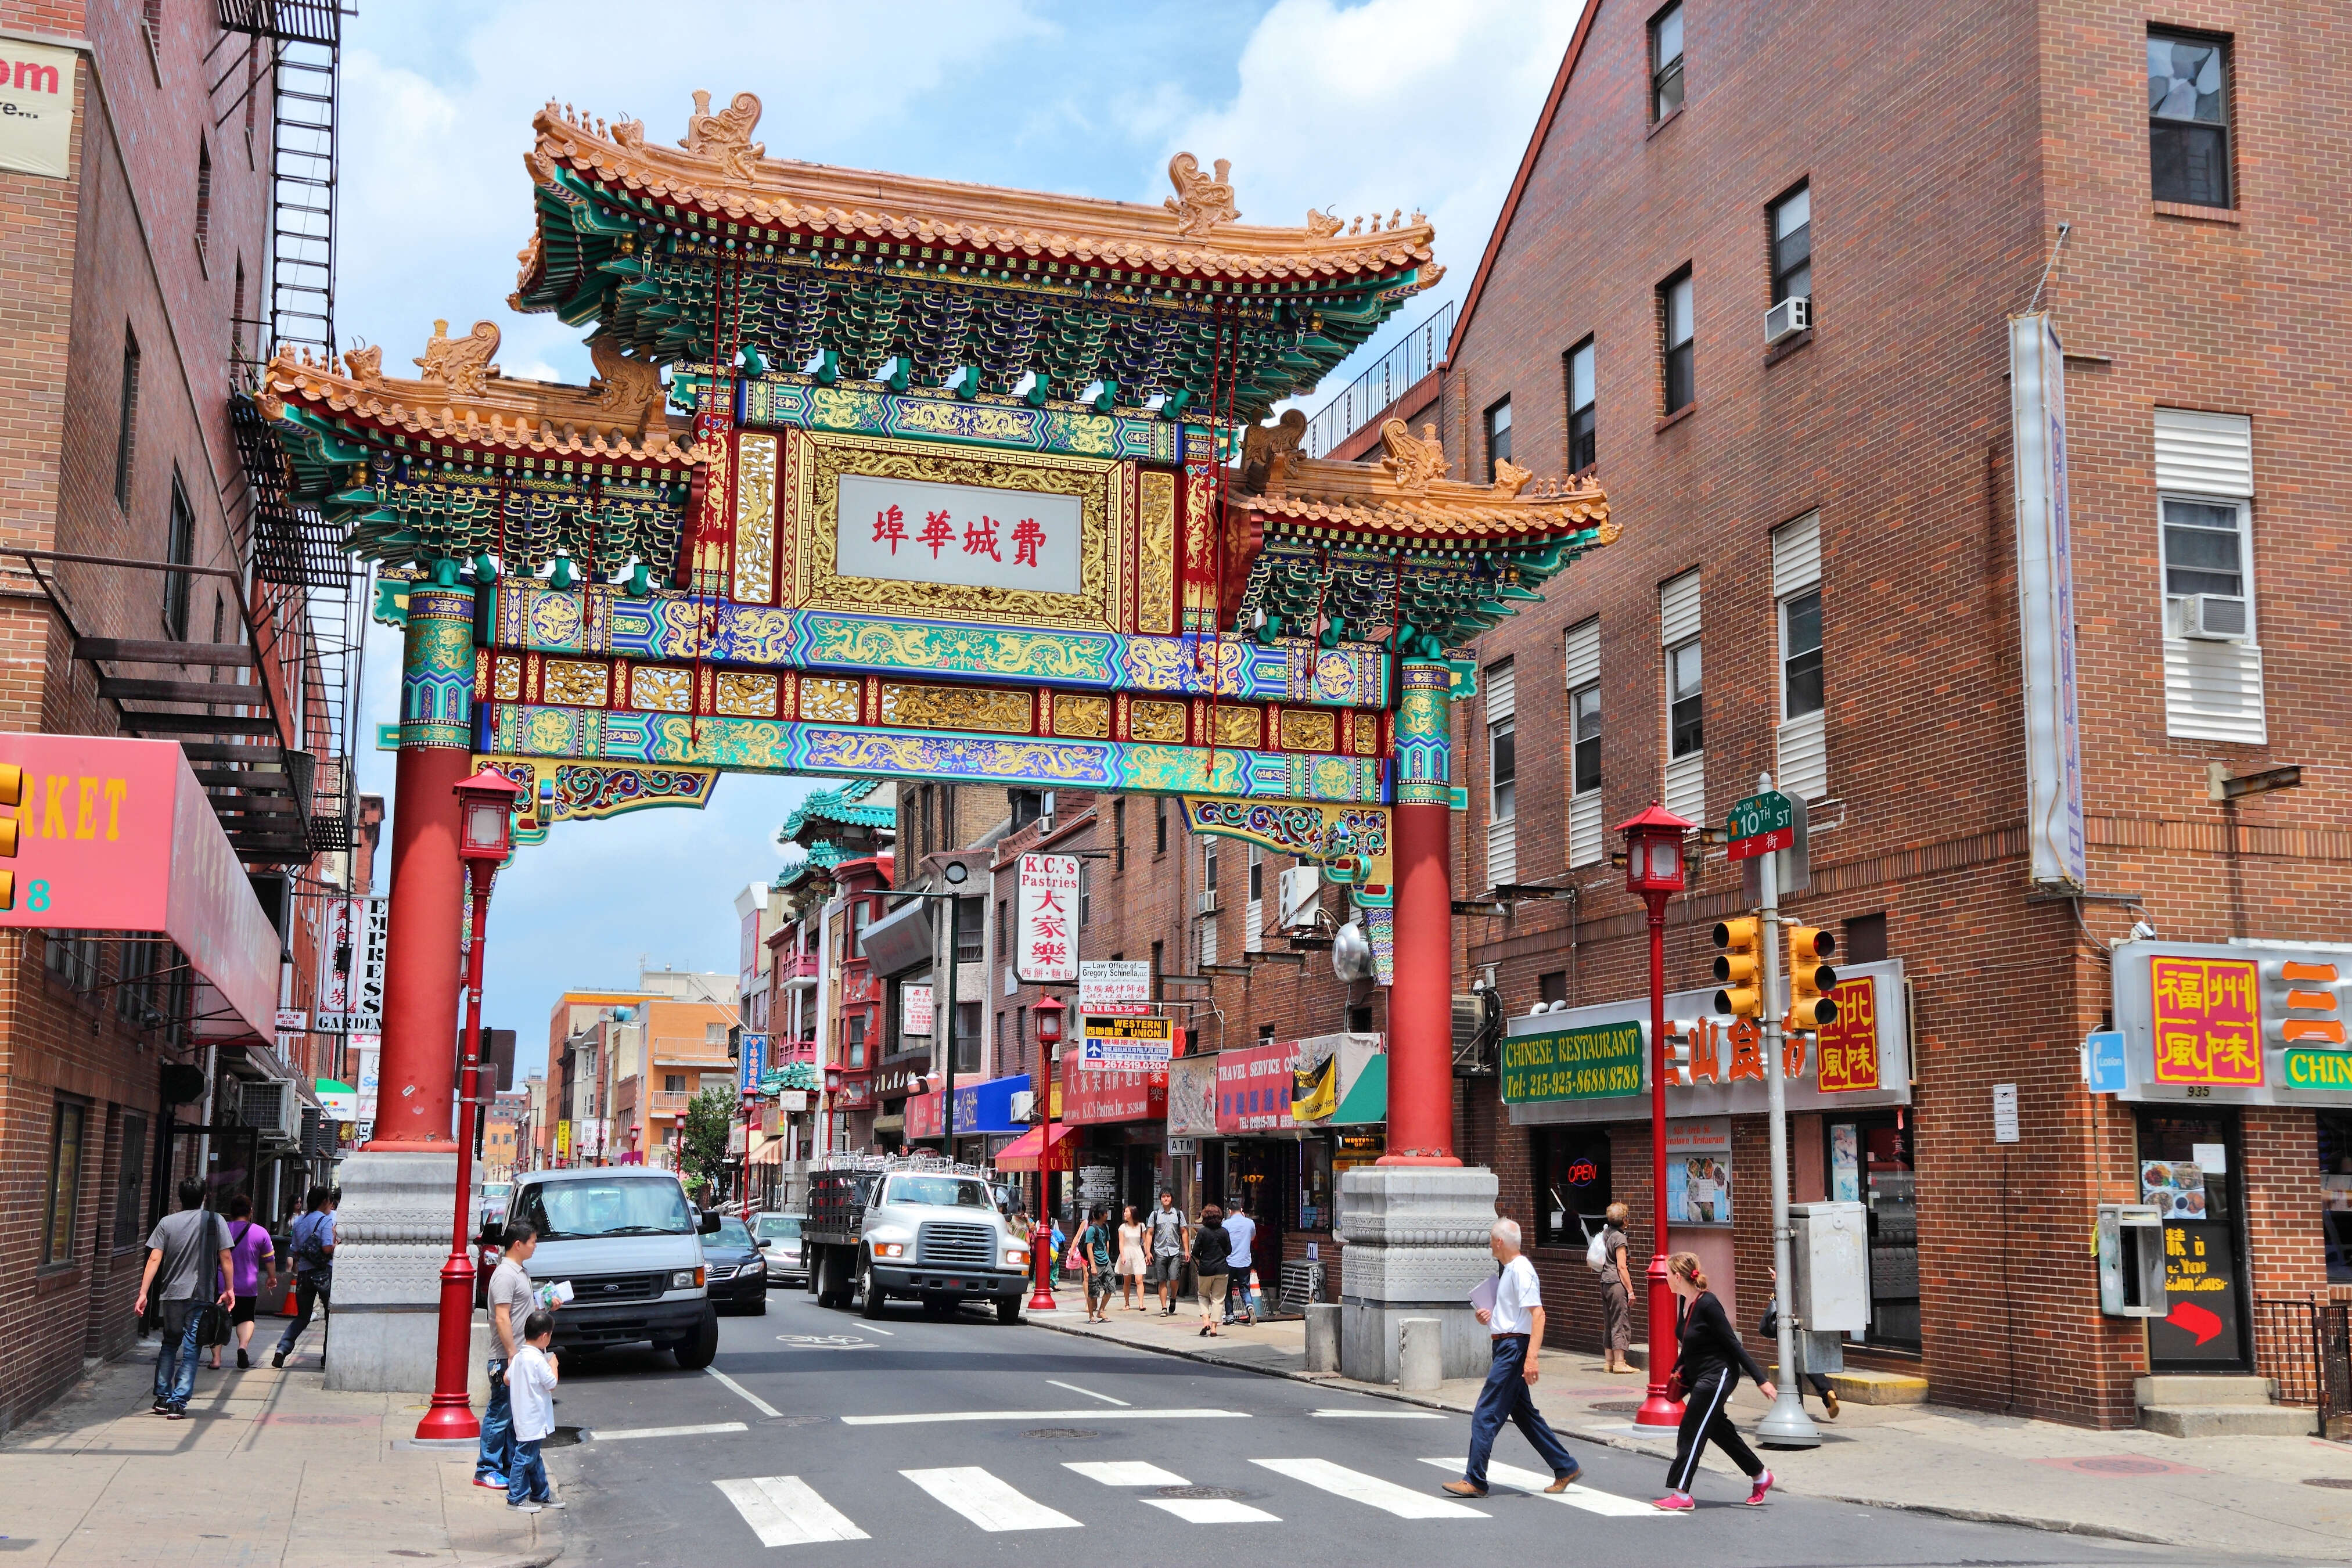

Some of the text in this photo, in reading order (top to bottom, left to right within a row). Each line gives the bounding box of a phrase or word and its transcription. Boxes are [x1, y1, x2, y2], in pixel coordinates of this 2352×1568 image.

[0, 102, 38, 118] e...
[2052, 427, 2077, 806] CHINATOWN
[1743, 802, 1753, 811] 100
[1755, 798, 1761, 808] N
[1776, 809, 1789, 826] ST
[1742, 834, 1778, 855] 十街
[1024, 856, 1074, 874] K.C.'s
[1022, 875, 1077, 889] Pastries
[1031, 890, 1066, 965] 大家樂
[362, 900, 388, 1014] EMPRESS
[1083, 969, 1107, 978] Gregory
[2158, 970, 2252, 1013] 福州
[1113, 1019, 1161, 1029] WESTERN
[1130, 1028, 1161, 1038] UNION
[1506, 1028, 1637, 1068] CHINESE RESTAURANT
[2160, 1032, 2255, 1073] 風味
[1104, 1060, 1168, 1070] 267.519.0204
[1218, 1063, 1246, 1081] TRAVEL
[1250, 1058, 1281, 1078] SERVICE
[1506, 1064, 1638, 1098] Tel: 215-925-8688/8788
[2187, 1086, 2211, 1097] 935
[1239, 1116, 1249, 1130] TEL:
[1688, 1125, 1700, 1134] Arch
[1171, 1141, 1193, 1150] ATM
[1666, 1134, 1725, 1145] hinatown Restaurant
[1569, 1164, 1597, 1182] OPEN
